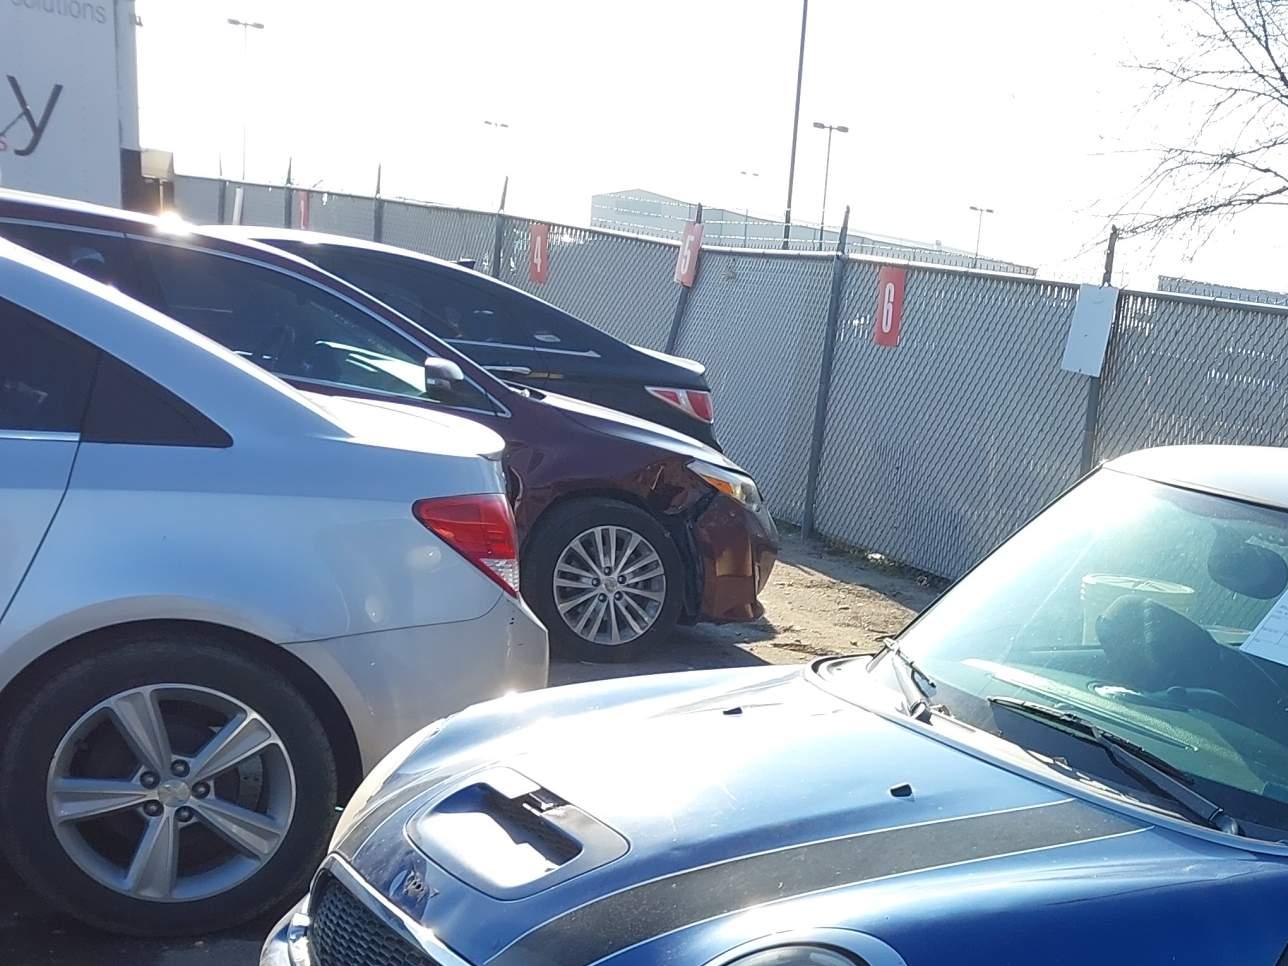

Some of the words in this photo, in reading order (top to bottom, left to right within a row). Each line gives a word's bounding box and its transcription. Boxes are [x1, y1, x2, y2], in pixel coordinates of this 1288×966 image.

[533, 235, 542, 273] 4
[680, 234, 695, 275] 5
[881, 282, 895, 333] 6
